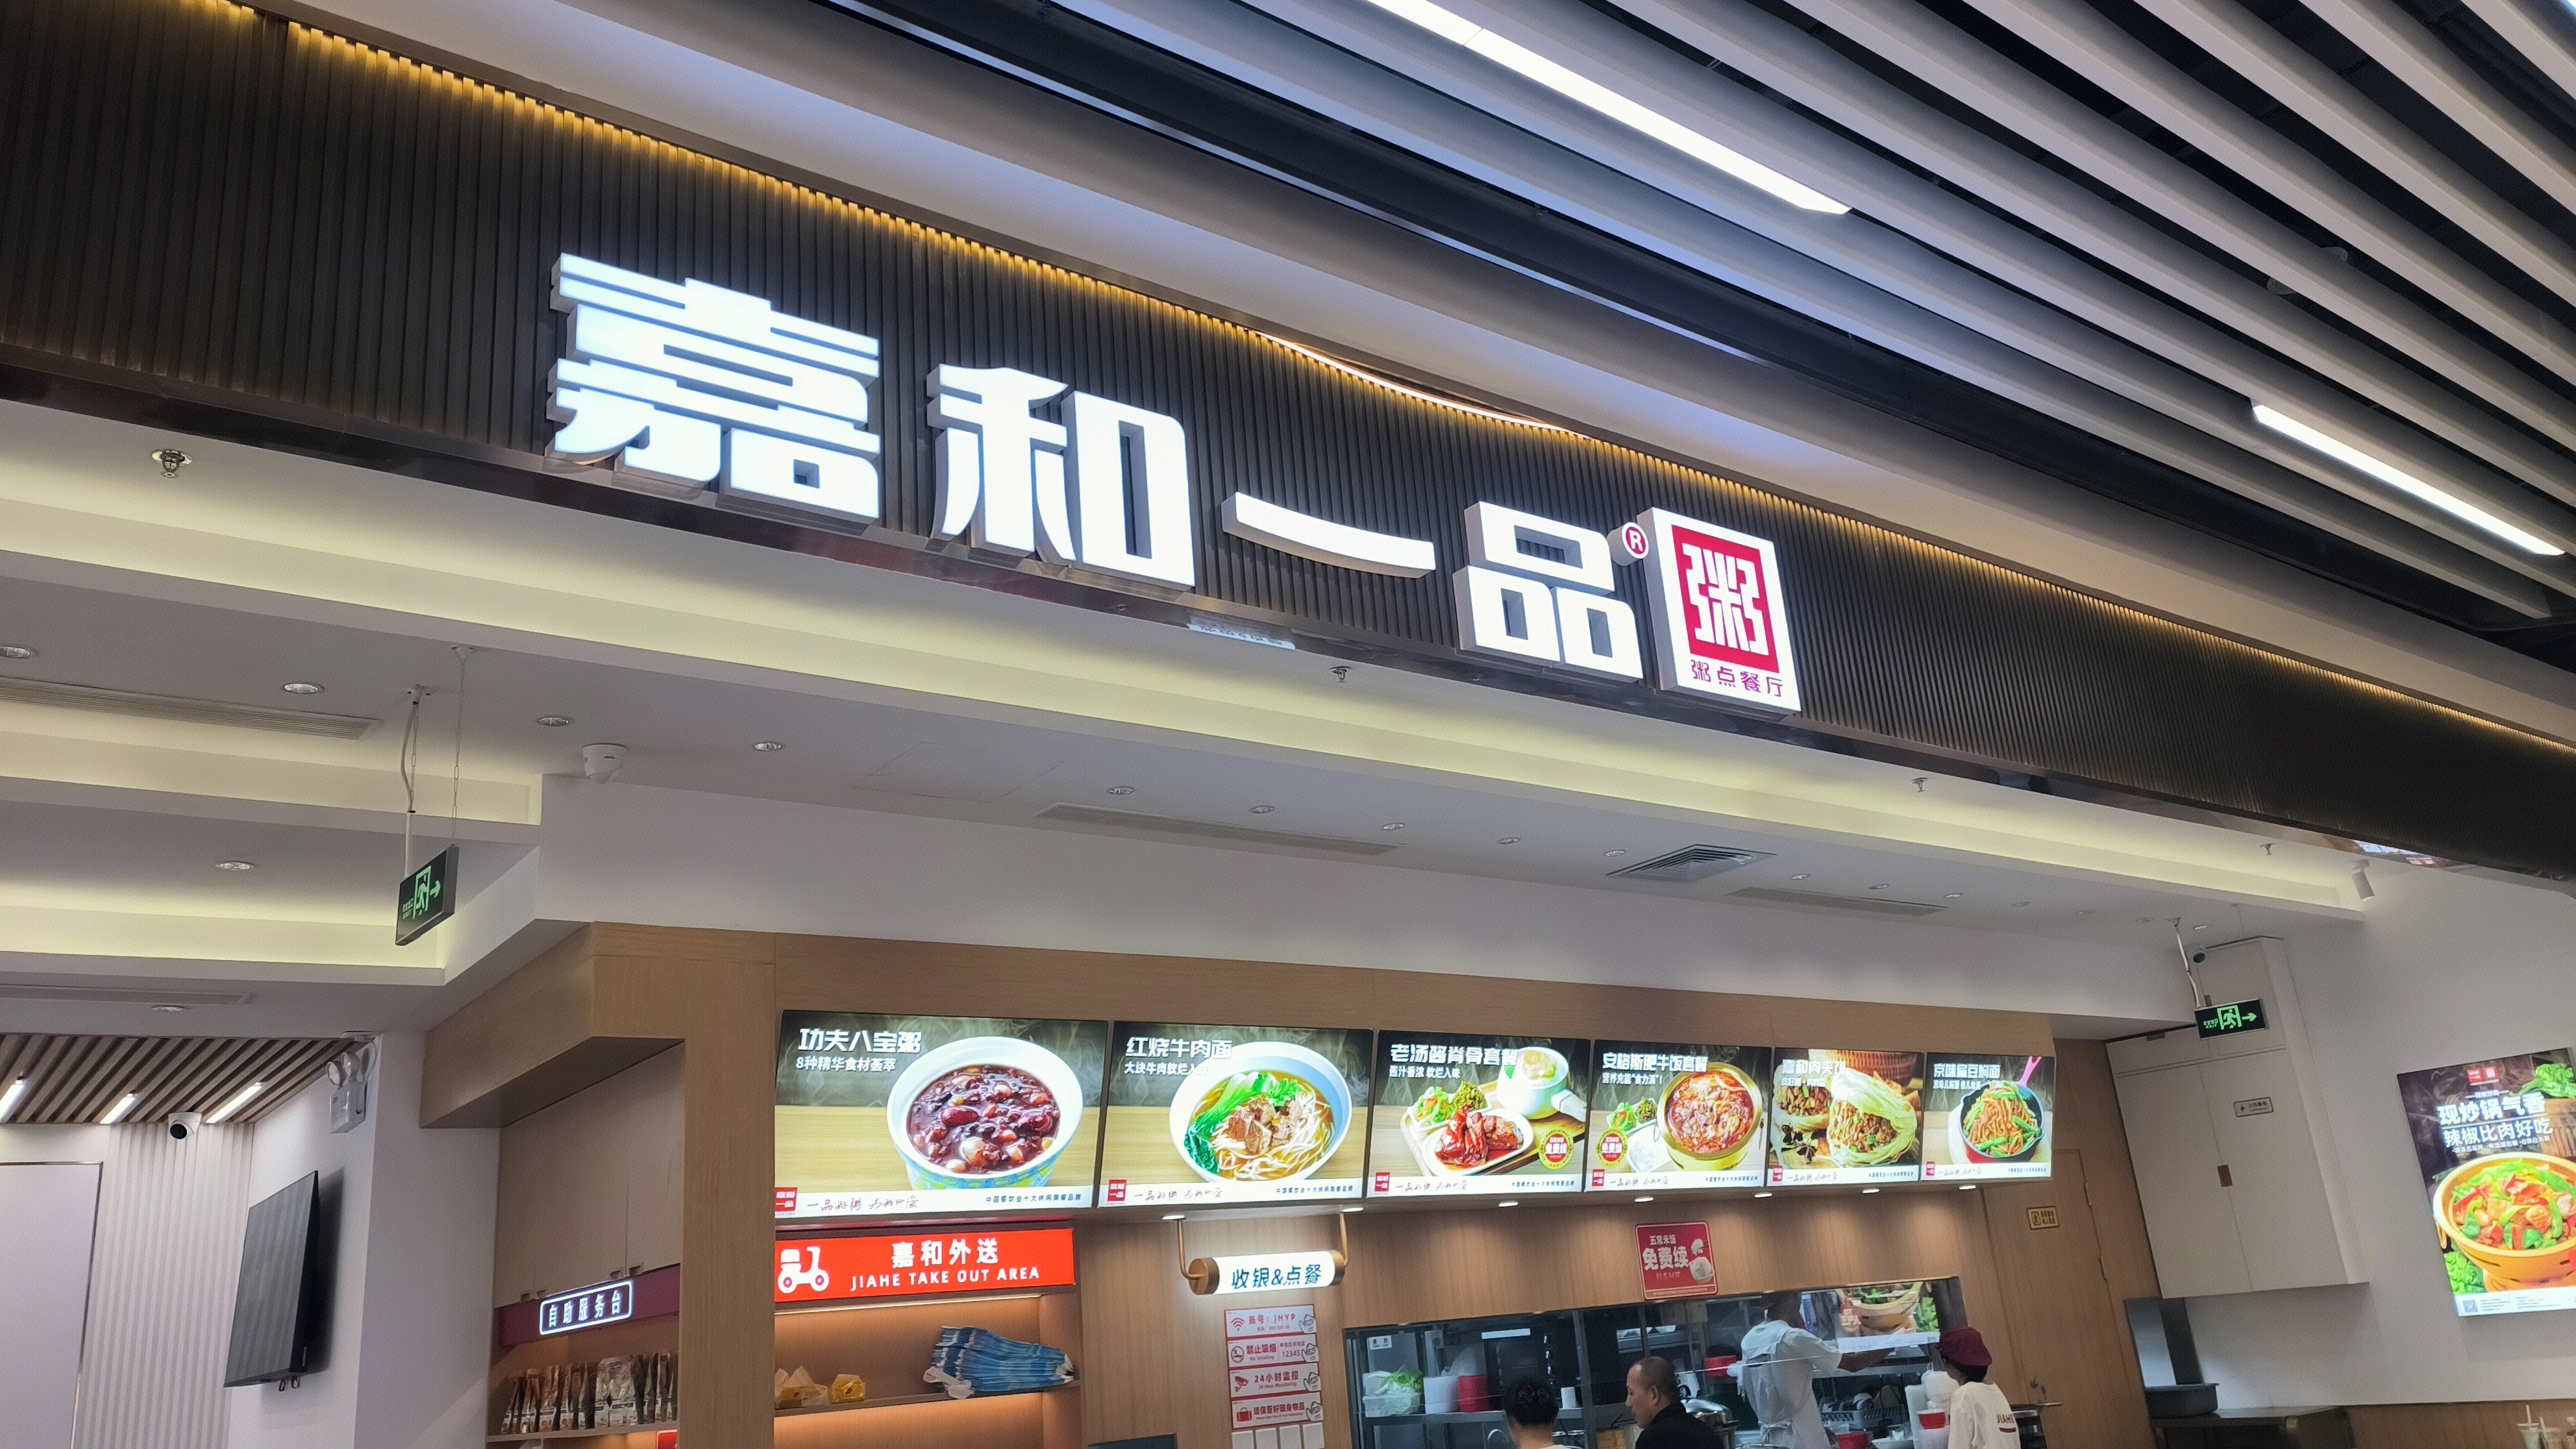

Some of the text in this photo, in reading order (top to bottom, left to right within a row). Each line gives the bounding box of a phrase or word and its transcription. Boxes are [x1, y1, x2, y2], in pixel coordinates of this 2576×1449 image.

[554, 251, 1644, 680] 嘉和一品
[1682, 541, 1770, 653] 粥
[1690, 659, 1783, 698] 粥点餐厅
[798, 1028, 921, 1053] 功夫八宝粥
[1125, 1037, 1232, 1059] 红烧牛肉面
[796, 1056, 897, 1072] 8种精华食材荟萃
[1602, 1052, 1708, 1072] 安格斯肥牛饭套餐
[2436, 1091, 2545, 1125] 现炒锅气香
[2442, 1117, 2553, 1148] 辣椒比肉好吃
[891, 1238, 998, 1269] 嘉和外送
[1642, 1246, 1689, 1270] 免费续
[850, 1267, 1039, 1292] JIAHE TAKE OUT AREA
[1232, 1264, 1321, 1289] 收银&点餐
[549, 1290, 622, 1328] 自助服务台
[1274, 1313, 1295, 1324] JHYP
[1246, 1343, 1276, 1354] 禁止吸烟
[1254, 1370, 1299, 1383] 24小时监控
